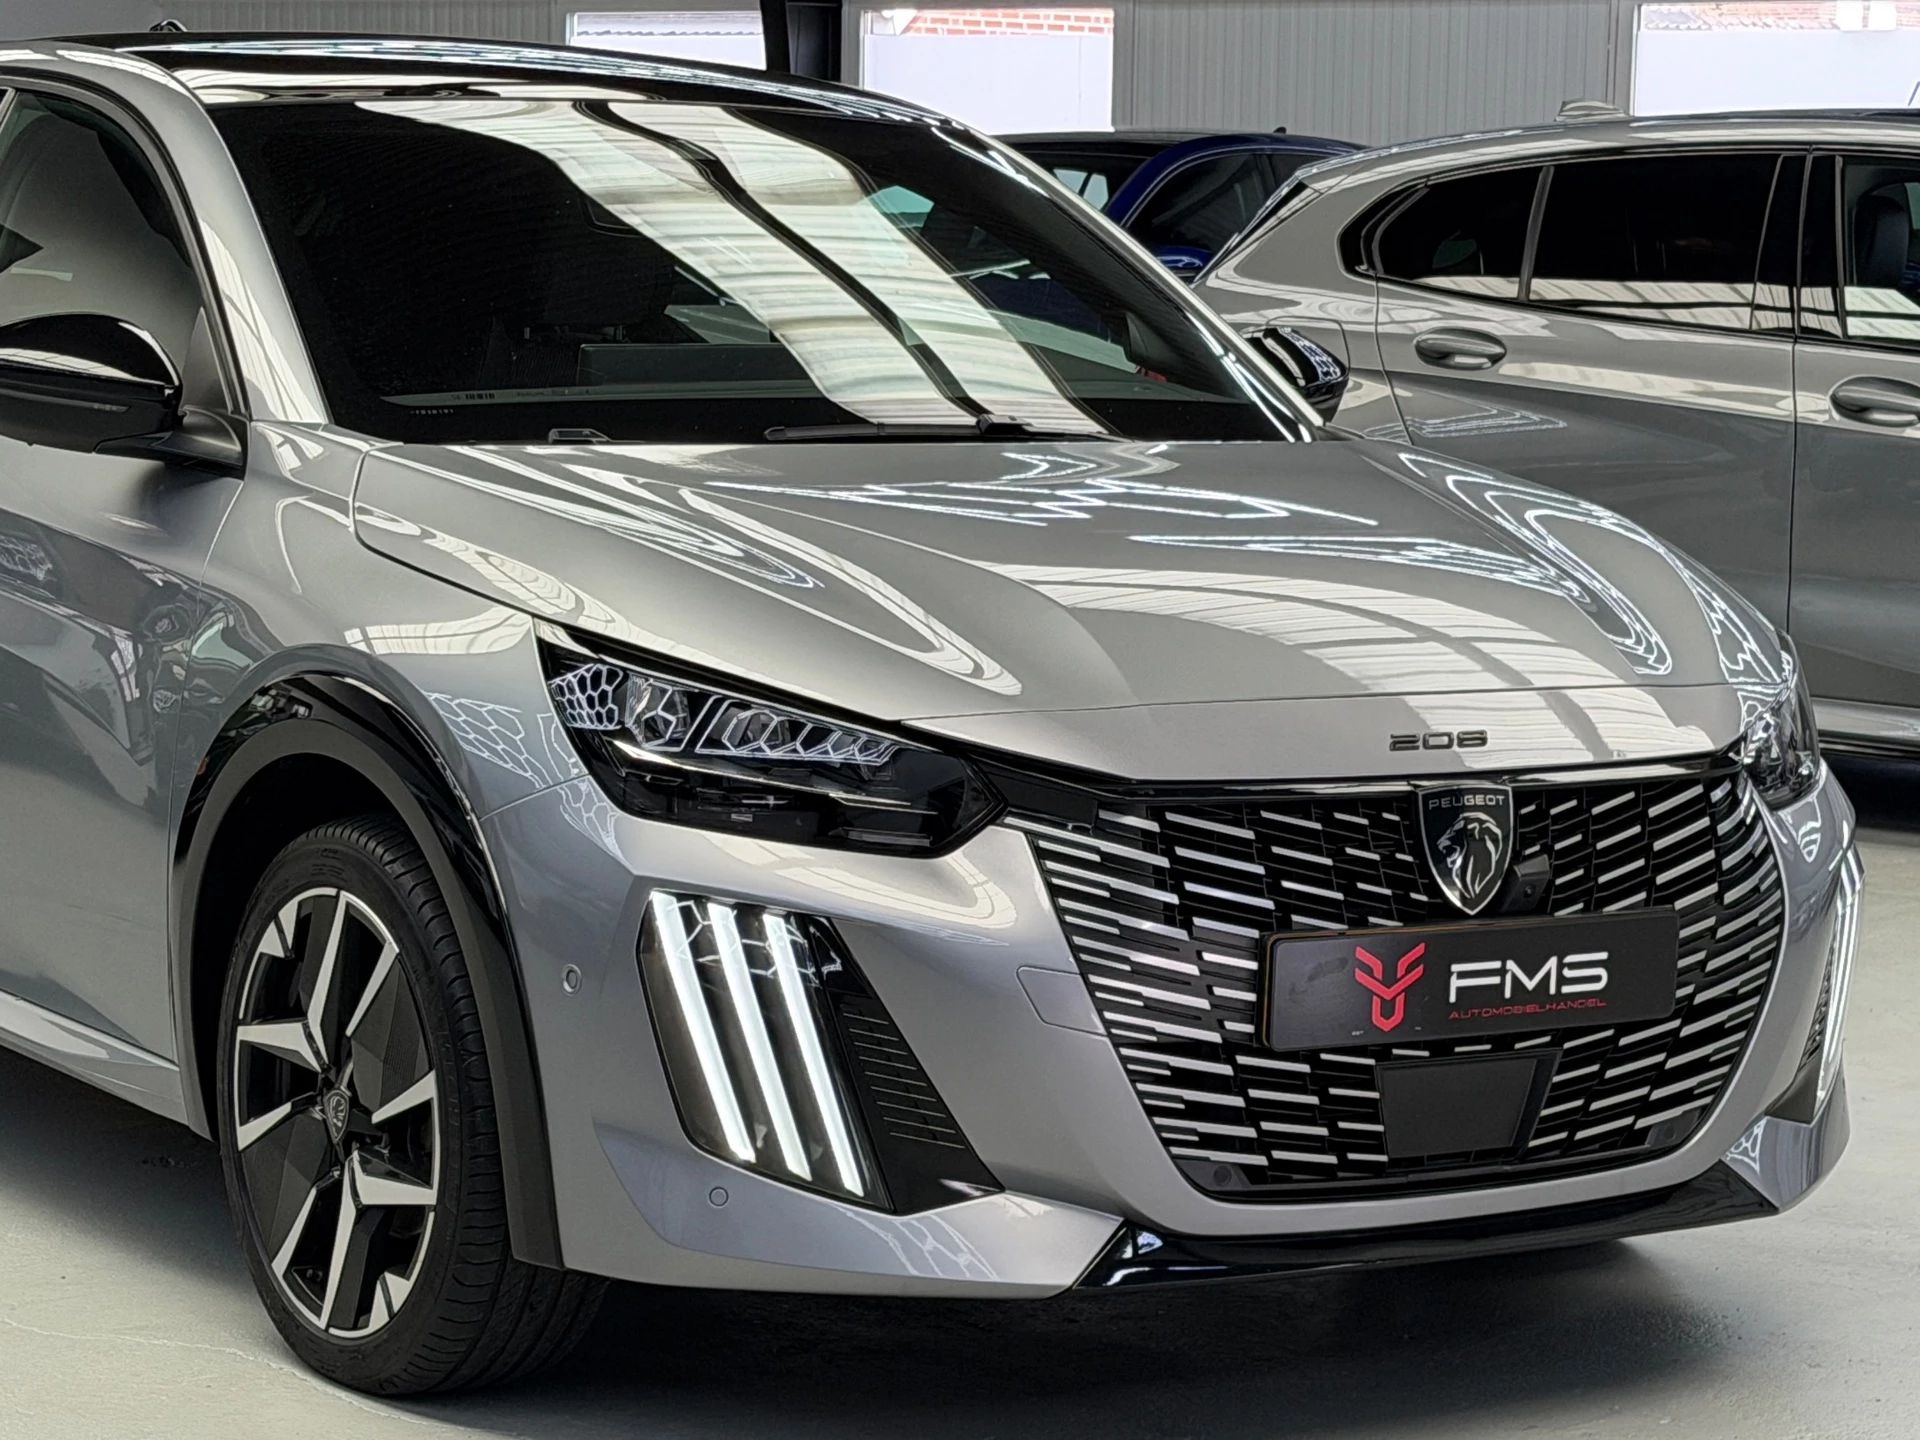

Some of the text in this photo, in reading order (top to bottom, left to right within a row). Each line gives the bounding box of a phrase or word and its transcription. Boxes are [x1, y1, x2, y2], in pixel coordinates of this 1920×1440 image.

[1389, 730, 1488, 752] 208
[1429, 795, 1505, 810] PEUGEOT
[1449, 951, 1609, 1003] FMS
[1449, 998, 1607, 1020] AUTOMOBIELHANDEL
